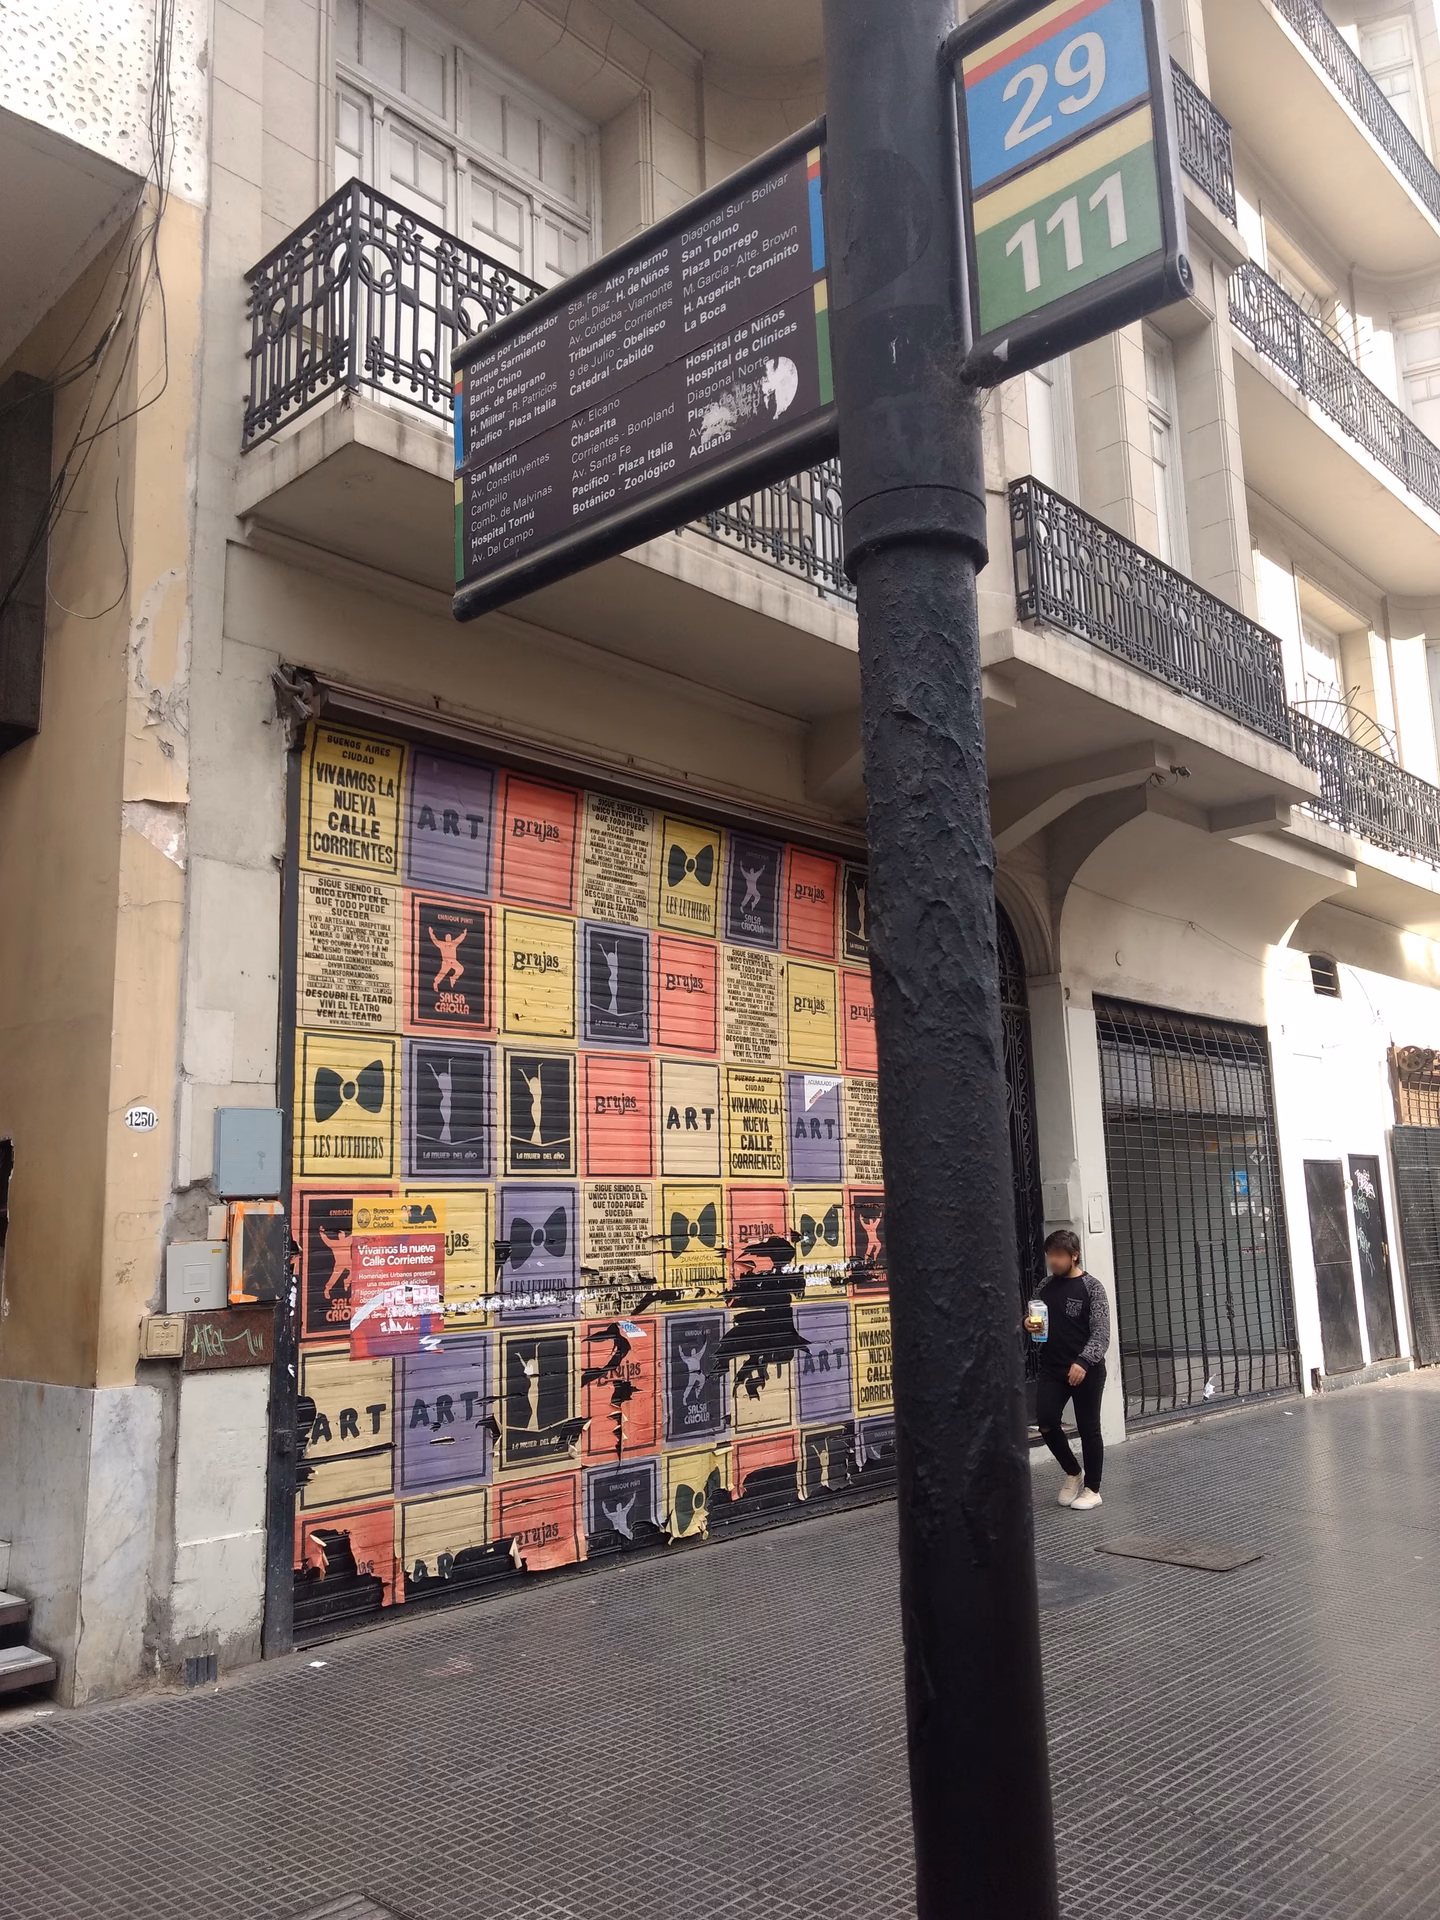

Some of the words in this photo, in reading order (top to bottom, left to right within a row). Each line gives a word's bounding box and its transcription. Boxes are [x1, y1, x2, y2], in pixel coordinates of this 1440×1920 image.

[1002, 31, 1106, 152] 29
[681, 210, 723, 245] Diagonal
[726, 200, 744, 217] Sur
[751, 173, 788, 202] Bolívar
[681, 245, 701, 262] San
[704, 223, 739, 247] Telmo
[1005, 170, 1128, 293] 111
[682, 258, 709, 280] Plaza
[713, 229, 758, 262] Dorrego
[683, 283, 695, 297] M.
[697, 265, 728, 288] García
[736, 249, 760, 267] Alte.
[762, 225, 797, 251] Brown
[568, 300, 584, 314] Sta.
[586, 291, 597, 303] Fe
[604, 275, 624, 292] Alto
[627, 248, 668, 278] Palermo
[683, 301, 694, 315] H.
[695, 275, 740, 308] Argerich
[748, 243, 798, 277] Caminito
[568, 311, 589, 330] Cnel.
[591, 300, 609, 317] Díaz
[616, 289, 626, 302] H.
[627, 283, 639, 295] de
[640, 264, 669, 287] Niños
[568, 334, 582, 347] Av.
[584, 310, 621, 337] Córdoba
[627, 280, 672, 311] Viamonte
[684, 319, 696, 332] La
[699, 303, 726, 323] Boca
[470, 354, 495, 374] Olivos
[497, 344, 511, 360] por
[513, 315, 558, 348] Libertador
[568, 330, 616, 362] Tribunales
[624, 297, 672, 331] Corrientes
[685, 335, 730, 368] Hospital
[734, 329, 747, 342] de
[751, 309, 784, 333] Niños
[569, 369, 574, 379] 9
[577, 363, 588, 375] de
[590, 349, 614, 367] Julio
[623, 319, 665, 348] Obelisco
[686, 353, 731, 386] Hospital
[734, 347, 748, 360] de
[751, 322, 796, 351] Clínicas
[470, 367, 498, 390] Parque
[500, 339, 545, 371] Sarmiento
[569, 365, 609, 395] Catedral
[615, 344, 653, 370] Cabildo
[687, 370, 734, 404] Diagonal
[738, 355, 770, 377] Norte
[469, 385, 494, 405] Barrio
[496, 369, 521, 388] Chino
[470, 404, 492, 421] Bcas.
[493, 395, 504, 406] de
[506, 371, 545, 399] Belgrano
[470, 424, 479, 436] H.
[480, 410, 505, 430] Militar
[512, 401, 520, 412] R.
[522, 381, 557, 406] Patricios
[570, 418, 586, 431] Av.
[588, 398, 619, 421] Elcano
[470, 428, 502, 452] Pacífico
[508, 412, 531, 430] Plaza
[534, 398, 556, 416] Italia
[571, 418, 616, 447] Chacarita
[571, 433, 619, 463] Corrientes
[627, 402, 674, 435] Bonpland
[689, 426, 731, 458] Aduana
[470, 470, 486, 484] San
[488, 453, 517, 474] Martín
[470, 489, 484, 500] Av.
[486, 453, 549, 491] Constituyentes
[571, 468, 587, 481] Av.
[589, 452, 616, 471] Santa
[619, 444, 631, 456] Fe
[572, 473, 609, 497] Pacífico
[618, 456, 644, 475] Plaza
[647, 441, 672, 460] Italia
[572, 488, 615, 514] Botánico
[624, 459, 675, 489] Zoológico
[471, 491, 507, 515] Campillo
[471, 513, 495, 531] Comb.
[500, 506, 508, 517] de
[508, 485, 552, 513] Malvinas
[471, 522, 506, 548] Hospital
[508, 510, 534, 529] Tornú
[471, 553, 485, 564] Av.
[487, 541, 500, 556] Del
[503, 527, 533, 548] Campo
[327, 735, 362, 750] BUENOS
[365, 745, 390, 757] AIRES
[342, 750, 375, 765] CIUDAD
[316, 762, 376, 793] VIVAMOS
[378, 777, 394, 798] LA
[334, 790, 376, 817] NUEVA
[328, 812, 381, 840] CALLE
[417, 804, 484, 840] ART
[512, 817, 560, 843] Brujas
[313, 831, 393, 865] CORRIENTES
[310, 886, 335, 897] UNICO
[337, 891, 366, 902] EVENTO
[369, 895, 379, 903] EN
[381, 897, 390, 906] EL
[318, 878, 342, 889] SIGUE
[344, 882, 372, 894] SIENDO
[373, 887, 383, 896] EL
[794, 883, 825, 903] Brujas
[315, 896, 332, 907] QUE
[335, 899, 357, 910] TODO
[359, 902, 386, 914] PUEDE
[331, 908, 370, 920] SUCEDER
[666, 895, 677, 914] LES
[679, 898, 711, 922] LUTHIERS
[744, 914, 761, 925] SALSA
[741, 922, 764, 934] CRIOLLA
[513, 950, 559, 974] Brujas
[665, 972, 704, 993] Brujas
[434, 1001, 470, 1015] CRIOLLA
[439, 992, 466, 1005] SALSA
[793, 996, 825, 1015] Brujas
[734, 1074, 755, 1082] BUENOS
[745, 1084, 765, 1092] CIUDAD
[595, 1093, 637, 1115] Brujas
[667, 1106, 714, 1131] ART
[731, 1097, 767, 1114] VIVAMOS
[769, 1099, 779, 1115] LA
[128, 1111, 155, 1128] 1250
[743, 1116, 769, 1133] NUEVA
[795, 1117, 835, 1139] ART
[313, 1134, 331, 1158] LES
[333, 1135, 384, 1159] LUTHIERS
[740, 1134, 773, 1151] CALLE
[732, 1153, 781, 1170] CORRIENTES
[739, 1221, 774, 1243] Brujas
[358, 1244, 398, 1255] Vivamos
[399, 1243, 407, 1254] la
[409, 1244, 436, 1253] nueva
[362, 1256, 385, 1267] Calle
[387, 1254, 434, 1265] Corrientes
[803, 1347, 845, 1376] ART
[311, 1403, 387, 1445] ART
[409, 1391, 479, 1429] ART
[684, 1412, 710, 1424] CRIOLLA
[688, 1403, 707, 1415] SALSA
